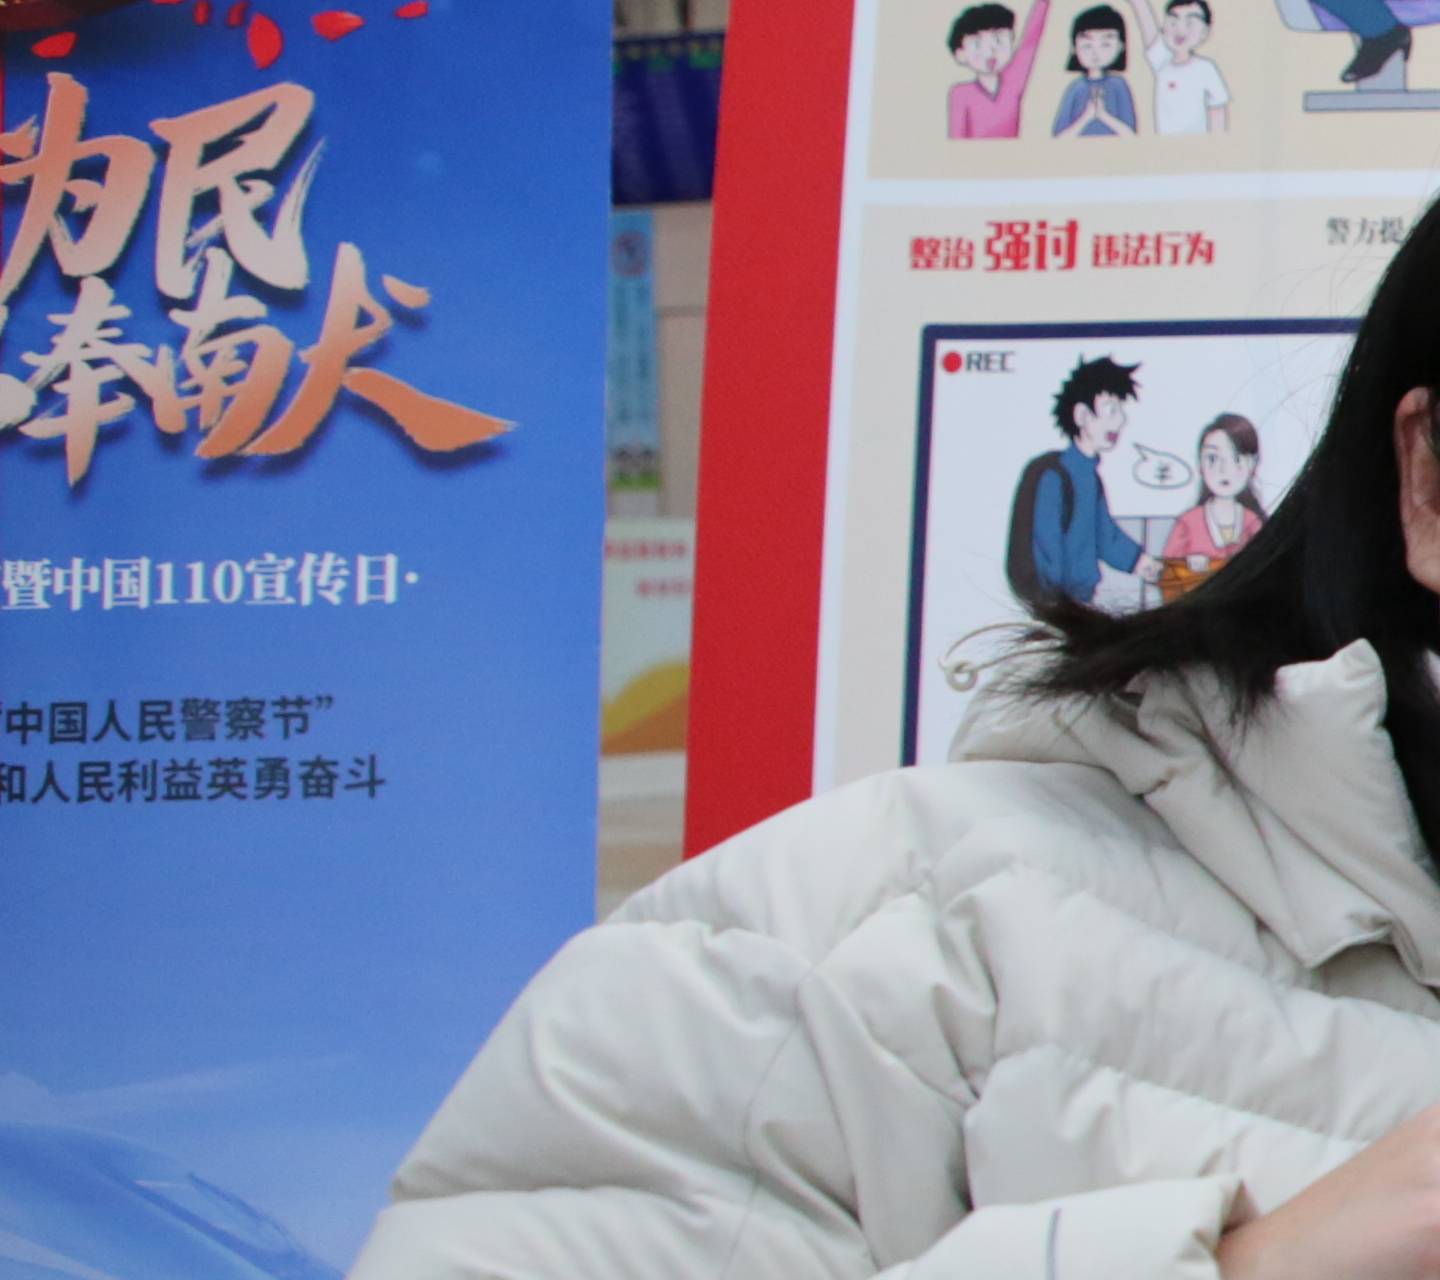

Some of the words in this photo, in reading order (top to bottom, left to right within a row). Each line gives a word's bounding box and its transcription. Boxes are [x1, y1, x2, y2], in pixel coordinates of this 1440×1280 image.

[909, 235, 974, 271] 整治
[984, 219, 1079, 272] 强讨
[1092, 232, 1215, 268] 违法行为
[965, 351, 1016, 373] REC
[0, 694, 334, 746] 中国人民警察节”
